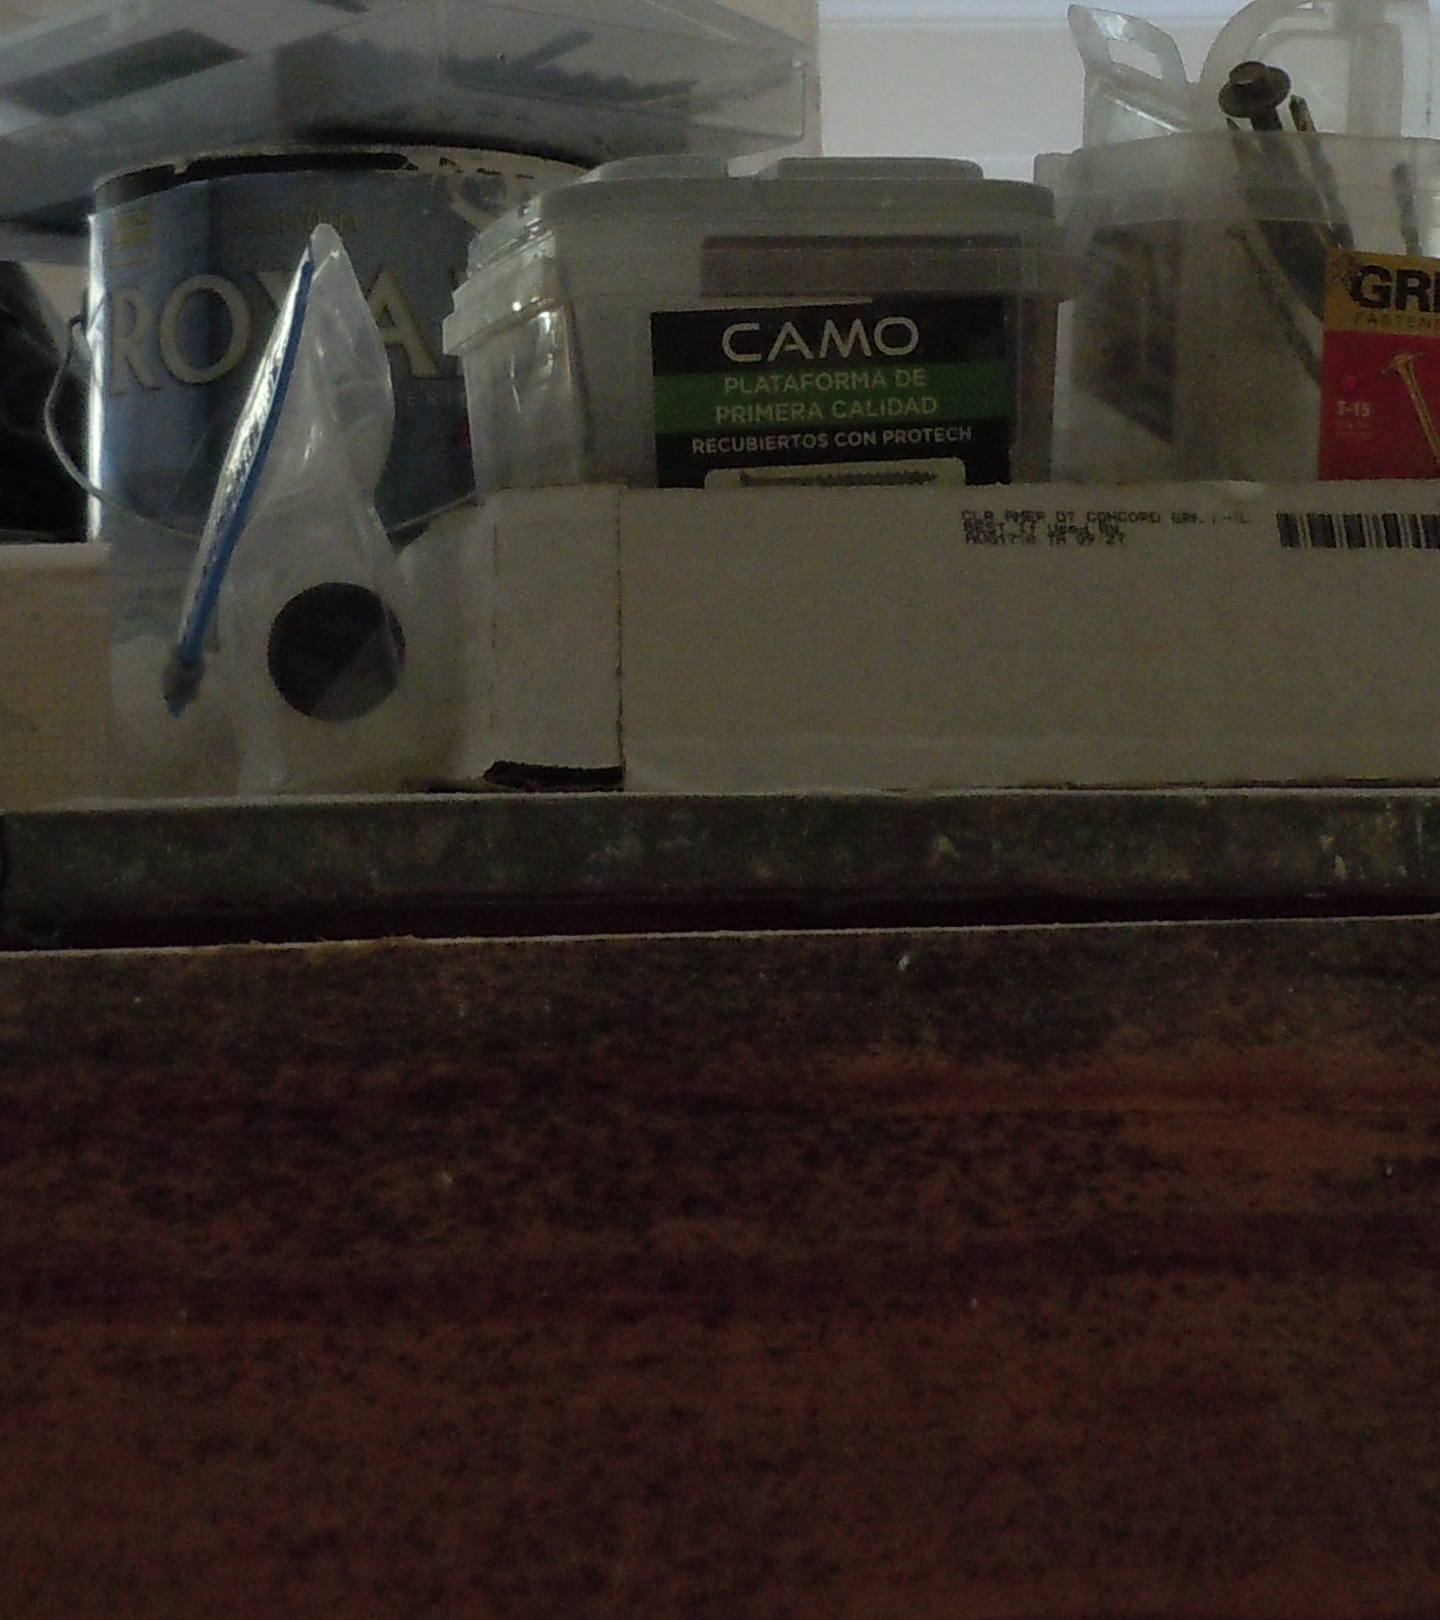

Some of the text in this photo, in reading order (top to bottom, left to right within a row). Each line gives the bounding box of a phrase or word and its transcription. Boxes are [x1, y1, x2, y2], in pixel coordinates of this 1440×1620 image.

[721, 316, 920, 363] CAMO
[724, 369, 927, 394] PLATAFORMA DE
[716, 396, 937, 424] PRIMERA CALIDAD
[1337, 400, 1371, 417] T-15
[691, 426, 972, 455] RECUBIERTOS CON PROTECH
